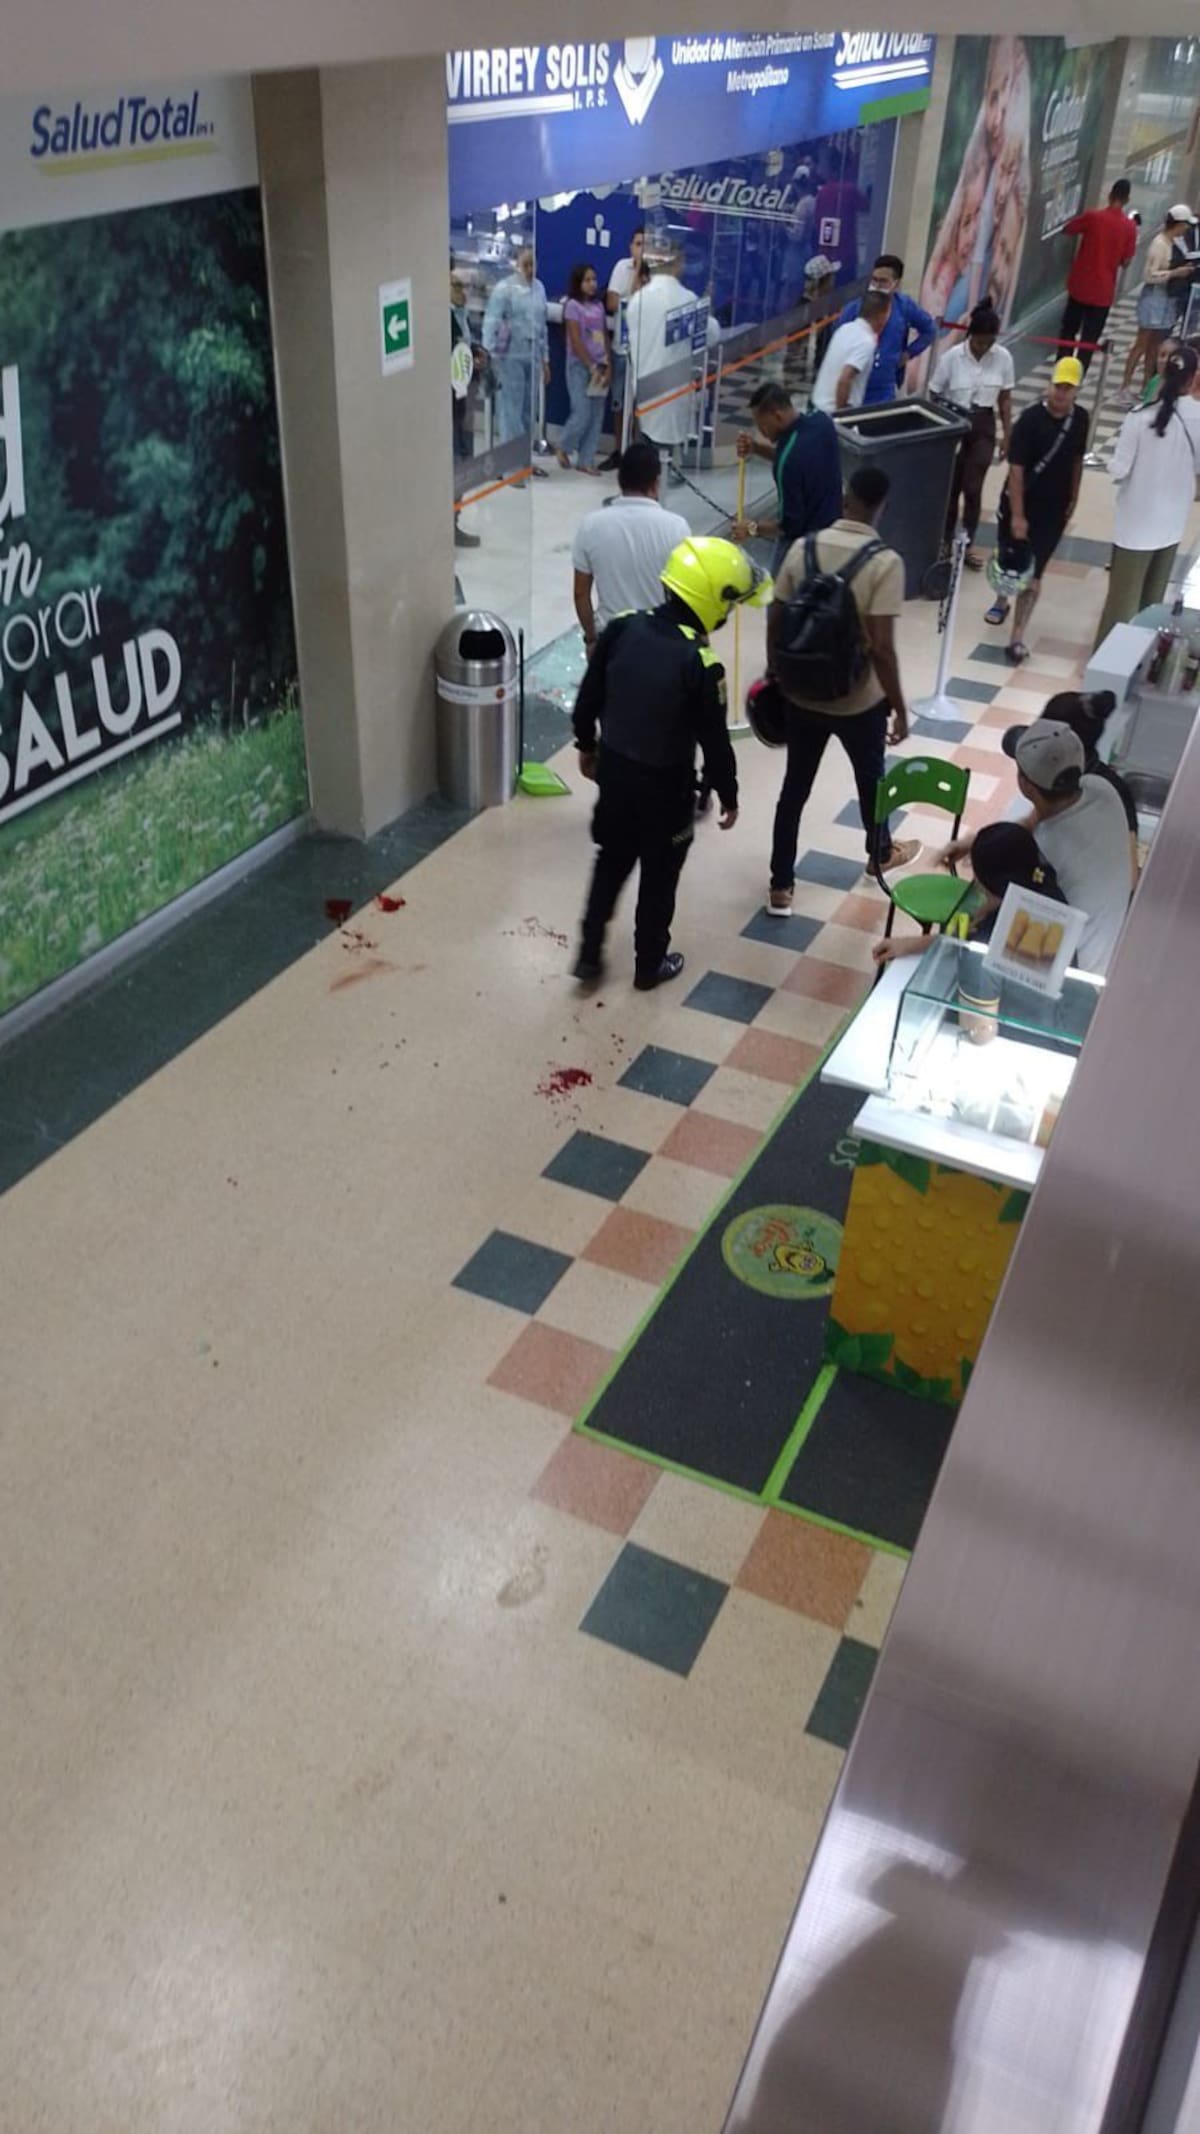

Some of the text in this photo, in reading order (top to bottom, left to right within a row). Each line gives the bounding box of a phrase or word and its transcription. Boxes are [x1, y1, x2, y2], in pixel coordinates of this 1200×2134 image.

[445, 43, 610, 99] VIRREY SOLIS
[671, 37, 711, 65] Unidad
[711, 38, 724, 62] de
[724, 34, 766, 60] Atención
[727, 64, 789, 96] Metropolitano
[0, 584, 101, 686] orar
